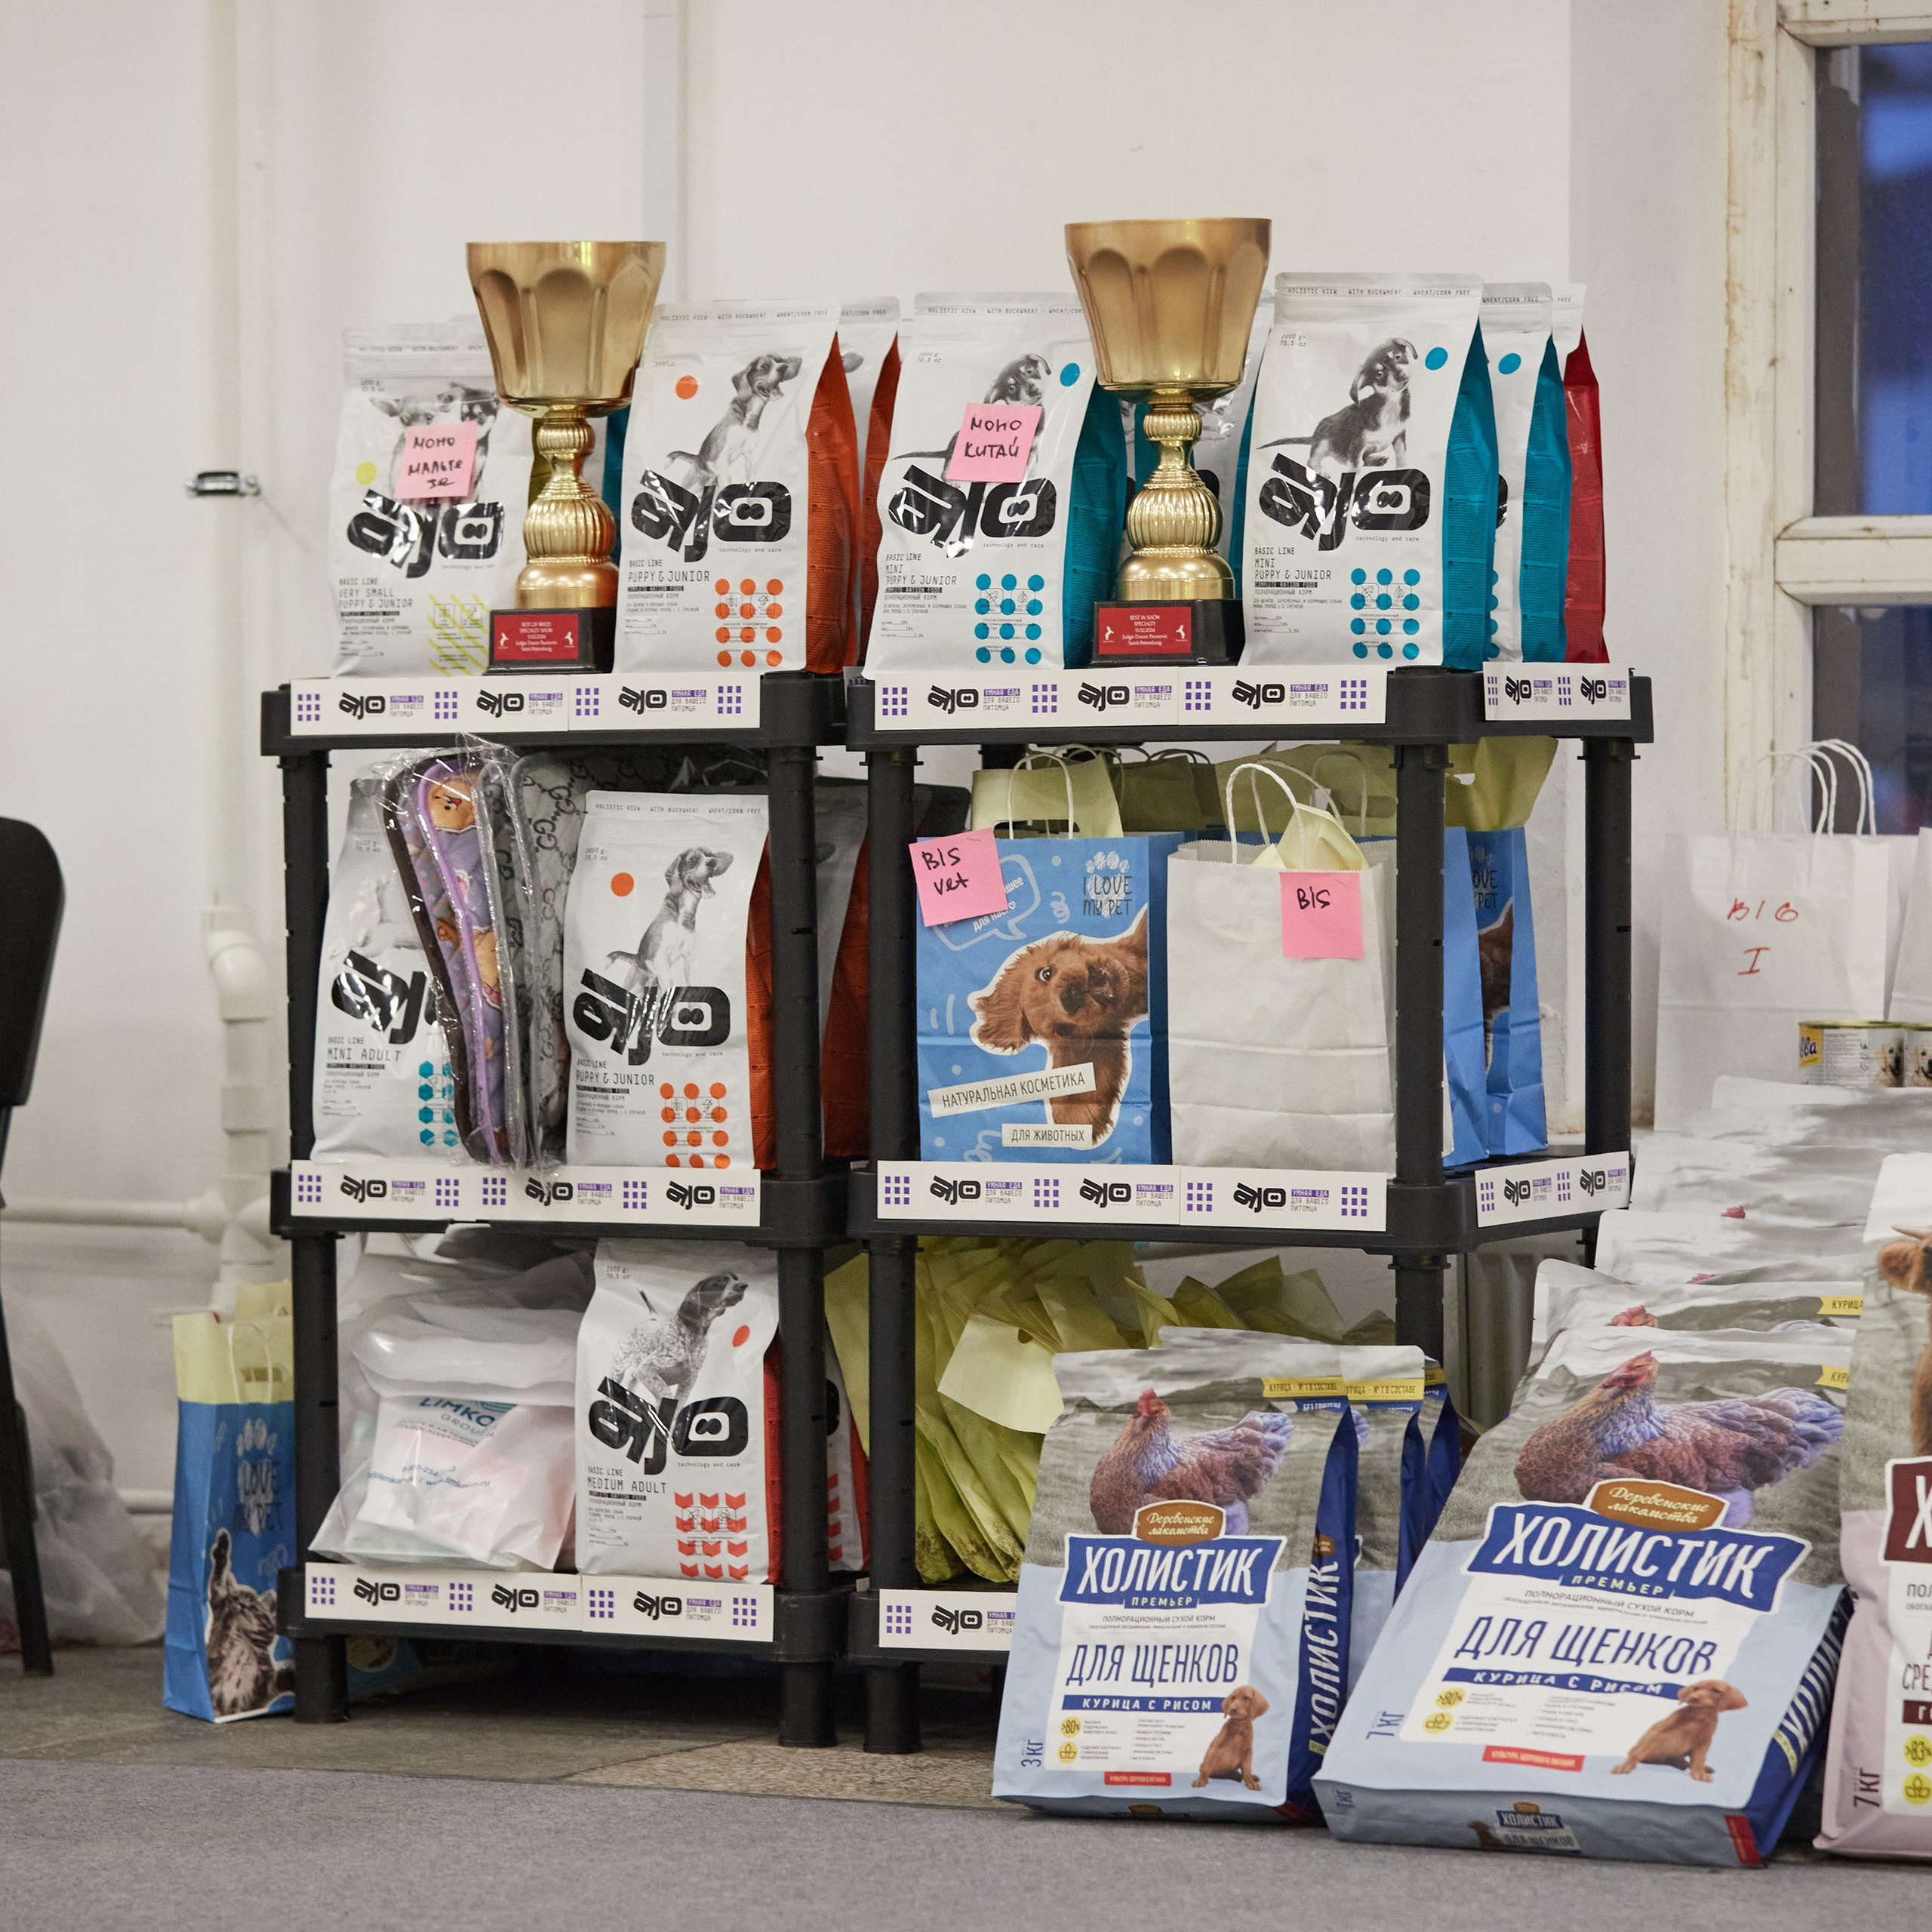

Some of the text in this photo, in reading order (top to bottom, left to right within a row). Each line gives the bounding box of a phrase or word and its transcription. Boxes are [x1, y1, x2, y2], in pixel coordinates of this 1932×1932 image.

[885, 565, 903, 574] MINI
[1254, 558, 1275, 568] MINI
[628, 571, 709, 583] PUPPY & JUNIOR
[911, 576, 915, 584] &
[920, 576, 957, 585] JUNIOR
[1254, 570, 1331, 580] PUPPY & JUNIOR
[366, 589, 394, 597] SMALL
[379, 598, 413, 608] JUNIOR
[1094, 875, 1132, 895] LOVE
[1107, 898, 1132, 916] PET
[328, 1048, 401, 1062] MINI ADULT
[603, 1073, 608, 1083] &
[613, 1073, 654, 1085] JUNIOR
[942, 1072, 1085, 1109] НАТУРАЛЬНАЯ КОСМЕТИКА
[1011, 1130, 1084, 1143] ДЛЯ ЖИВОТНЫХ
[1269, 1383, 1291, 1392] КУРИЦА
[1346, 1386, 1365, 1395] УРИЦА
[1390, 1386, 1416, 1394] СОСТАВЕ
[587, 1477, 666, 1494] MEDIUM ADULT
[1608, 1487, 1710, 1514] Деревенские
[1146, 1512, 1214, 1529] Деревенские
[1607, 1503, 1700, 1524] лакомства
[1148, 1524, 1209, 1536] лакомства
[1492, 1512, 1774, 1600] ХОЛИСТИК
[1076, 1546, 1263, 1596] ХОЛИСТИК
[1571, 1574, 1664, 1595] ПРЕМЬЕР
[1131, 1597, 1193, 1607] ПРЕМЬЕР
[1524, 1589, 1626, 1608] ПОЛНОРАЦИОННЫЙ
[1627, 1601, 1663, 1613] СУХОЙ
[1665, 1607, 1695, 1617] КОРМ
[1172, 1614, 1194, 1623] СУХОЙ
[1304, 1561, 1340, 1742] ХОЛИСТИК
[1454, 1615, 1718, 1676] ДЛЯ ЩЕНКОВ
[1066, 1644, 1238, 1688] ДЛЯ ЩЕНКОВ
[1473, 1672, 1662, 1694] КУРИЦА С РИСОМ
[1082, 1698, 1211, 1711] КУРИЦА С РИСОМ
[1021, 1758, 1041, 1767] 3
[1854, 1767, 1880, 1807] 7 КГ
[1500, 1812, 1558, 1829] ХОЛИСТИК
